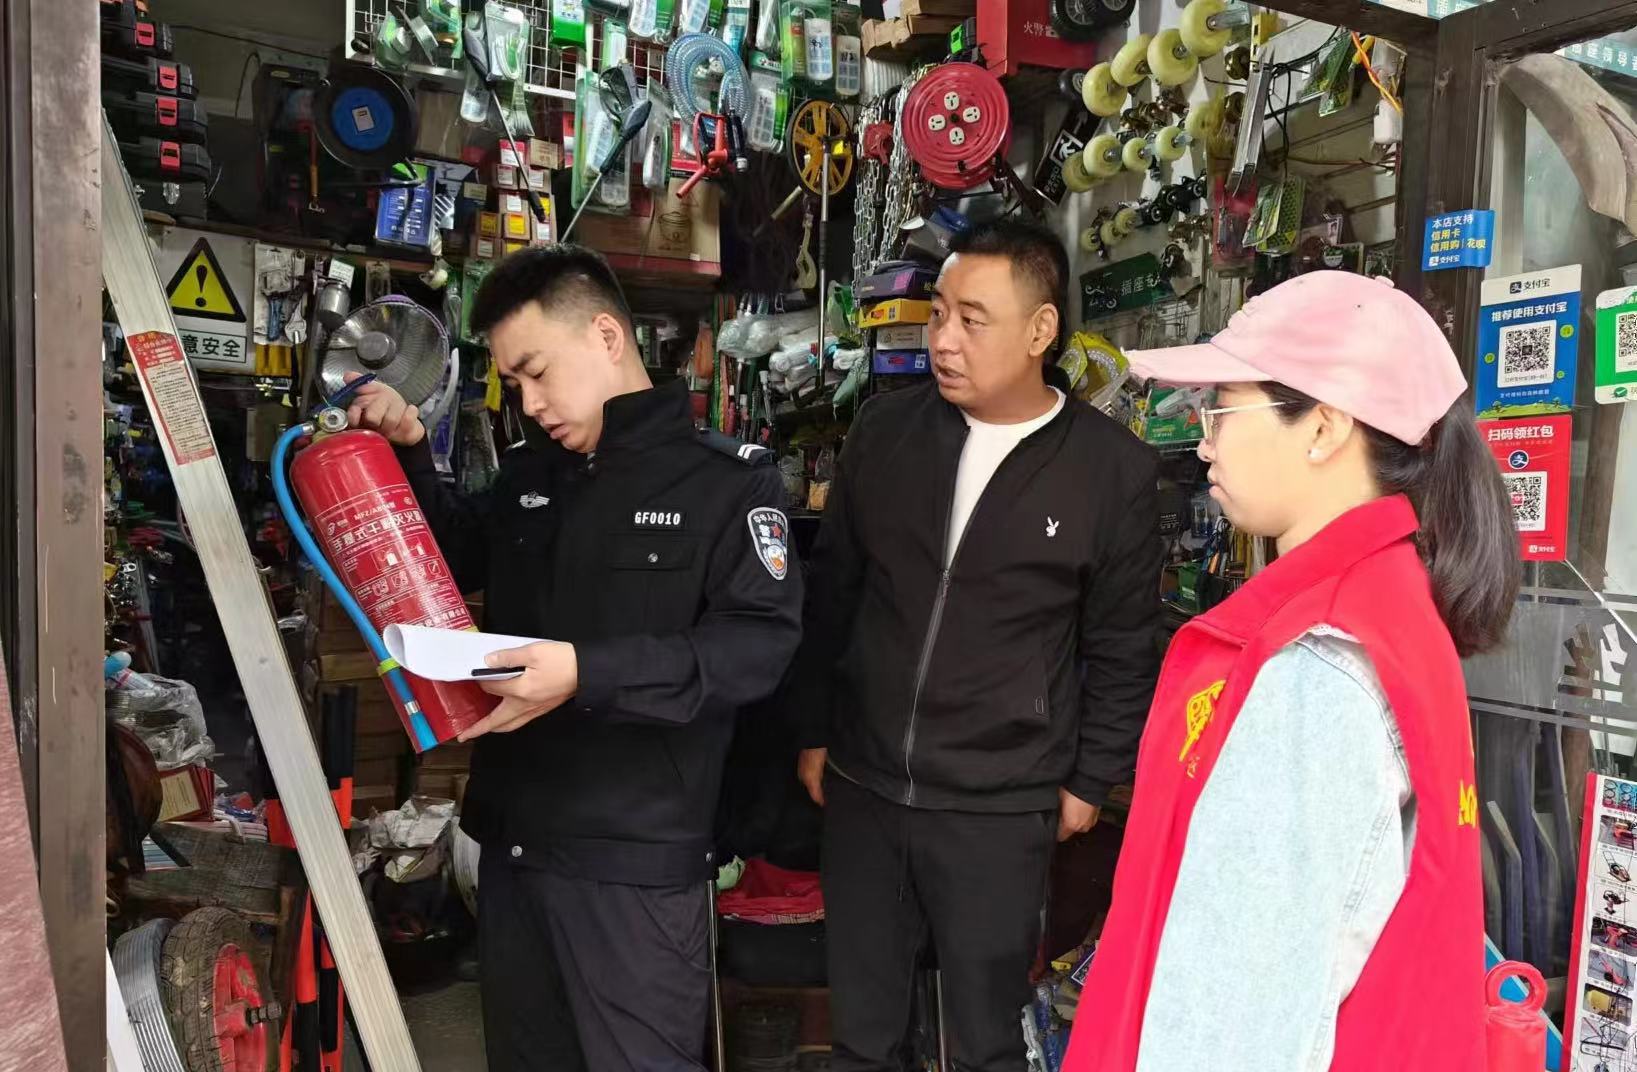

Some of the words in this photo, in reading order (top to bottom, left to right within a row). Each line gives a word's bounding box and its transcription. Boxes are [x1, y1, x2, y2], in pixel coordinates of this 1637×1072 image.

[1432, 213, 1474, 229] 本店支持
[1431, 228, 1461, 241] 信用卡
[1466, 237, 1486, 249] 花呗
[1523, 278, 1550, 290] 支付宝
[1491, 301, 1568, 322] 推荐使用支付宝
[1488, 425, 1554, 441] 扫码领红包
[634, 512, 681, 526] GF0010
